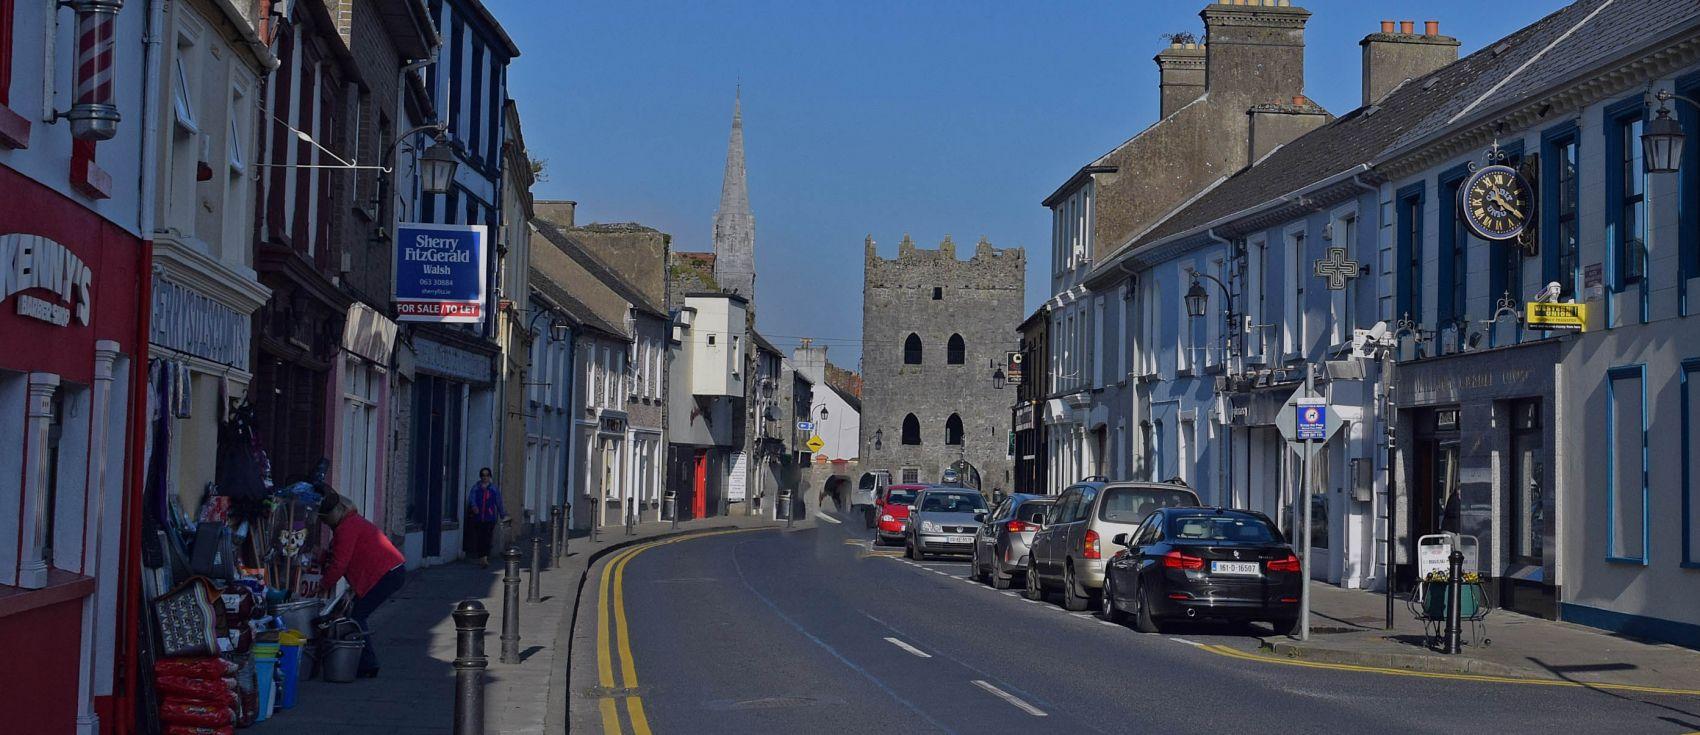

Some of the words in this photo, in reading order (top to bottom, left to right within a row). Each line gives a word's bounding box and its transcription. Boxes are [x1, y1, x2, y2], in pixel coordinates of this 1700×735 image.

[416, 235, 459, 252] Sherry
[405, 248, 470, 262] FitzGerald
[423, 264, 451, 275] Walsh
[0, 233, 92, 327] KENNY'S
[419, 278, 432, 286] 063
[397, 303, 415, 313] FOR
[460, 305, 476, 314] LET
